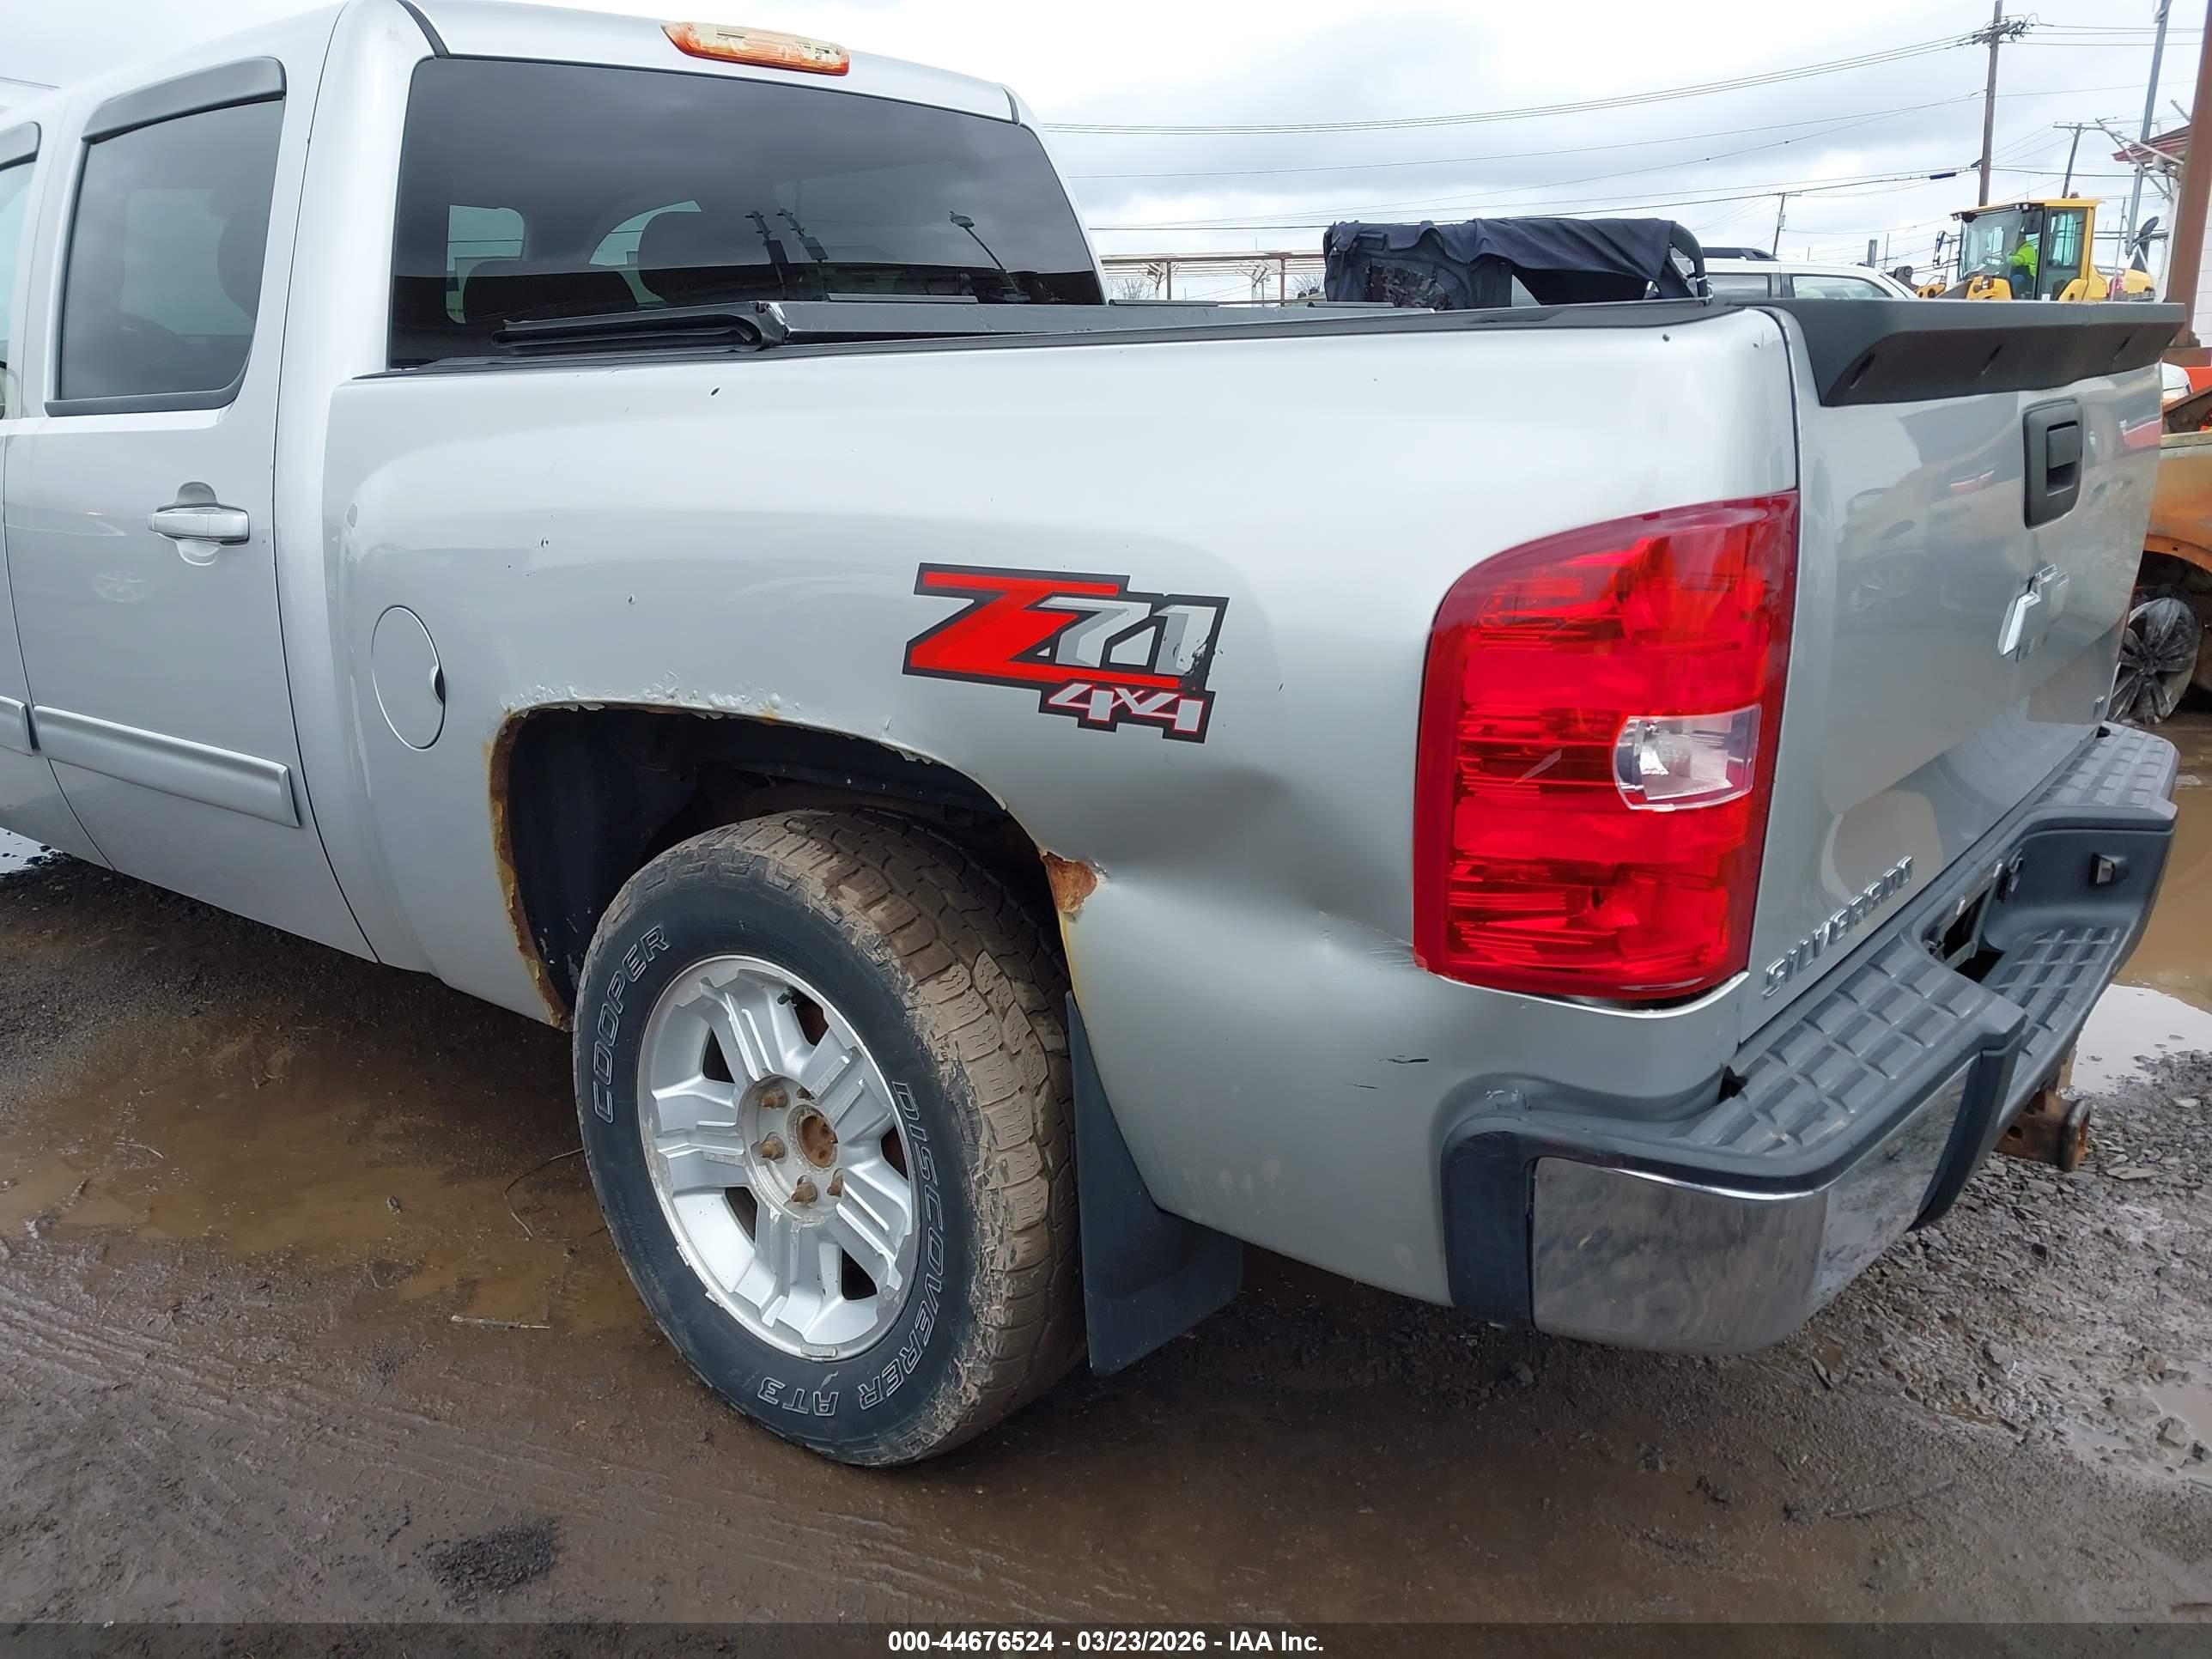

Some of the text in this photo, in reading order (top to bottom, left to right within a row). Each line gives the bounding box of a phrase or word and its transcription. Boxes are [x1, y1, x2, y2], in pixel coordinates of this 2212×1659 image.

[903, 563, 1226, 690] Z71
[1761, 855, 1913, 998] SILVERADO
[592, 924, 671, 1123] COOPER
[757, 1080, 945, 1417] DISCOVERER AT3
